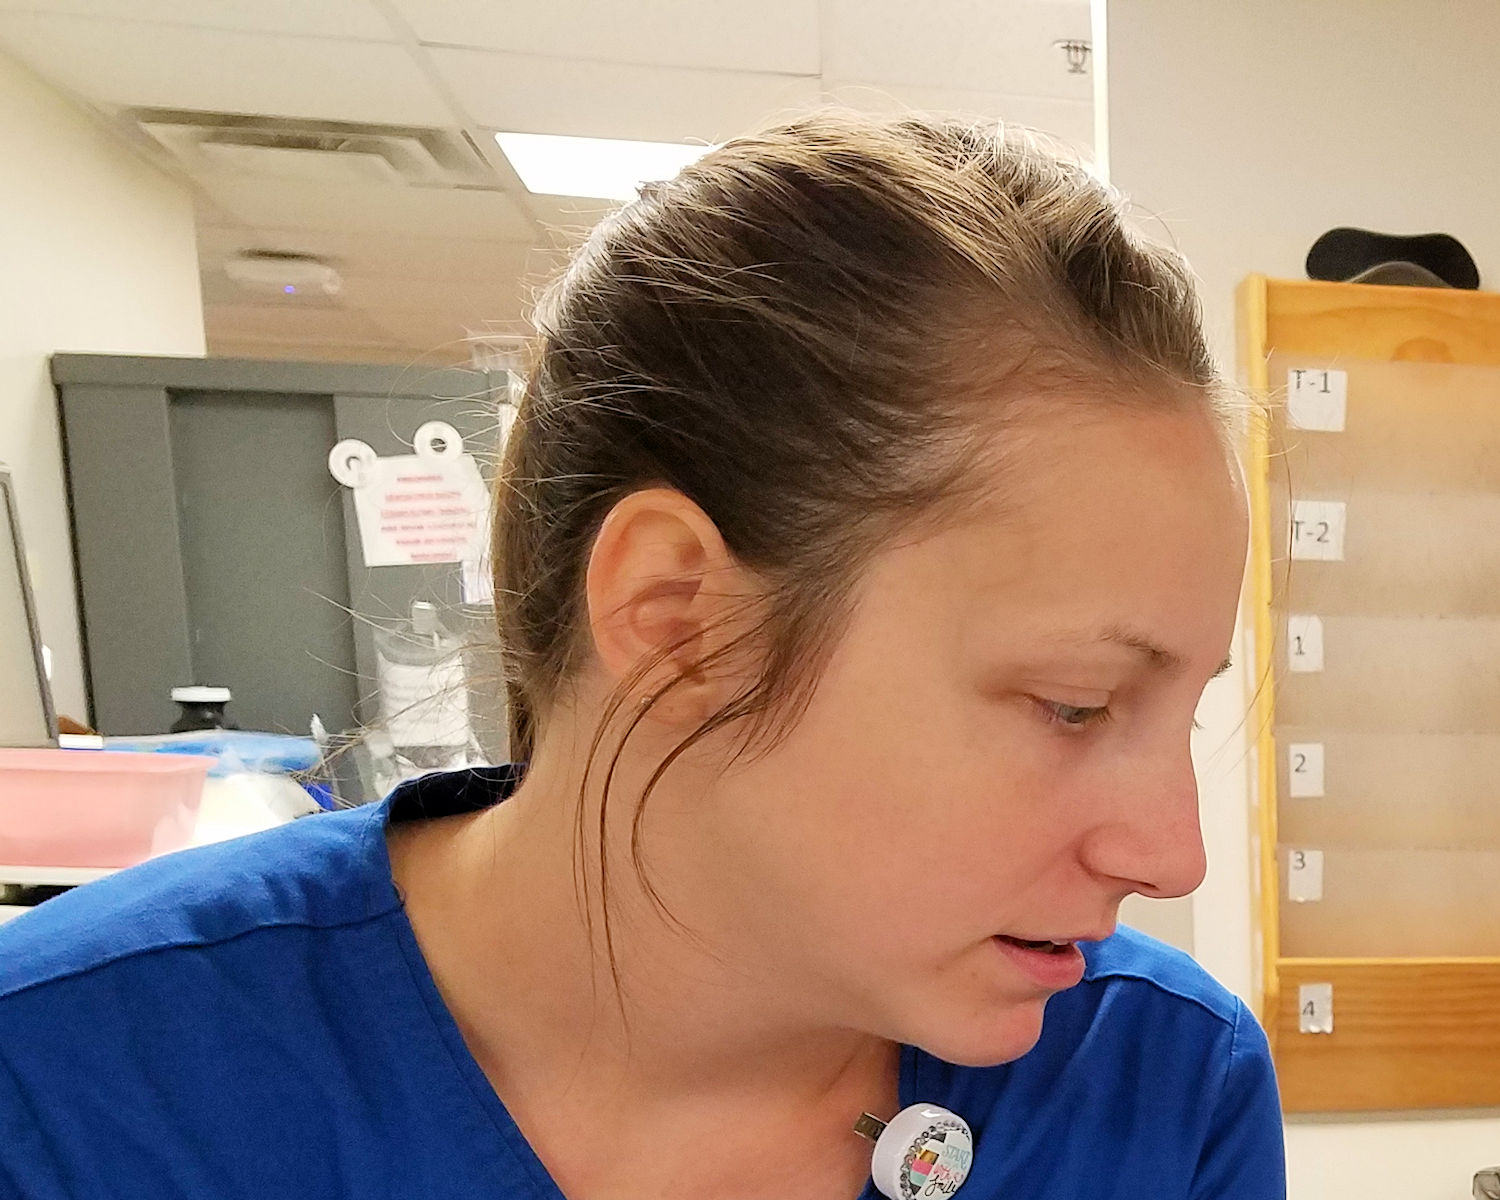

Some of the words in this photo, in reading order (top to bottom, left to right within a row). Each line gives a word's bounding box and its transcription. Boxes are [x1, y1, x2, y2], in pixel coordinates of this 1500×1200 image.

[1292, 369, 1332, 394] T-1
[1292, 520, 1331, 543] T-2
[1294, 636, 1306, 656] 1
[1294, 753, 1308, 774] 2
[1293, 850, 1307, 871] 3
[1302, 999, 1316, 1017] 4
